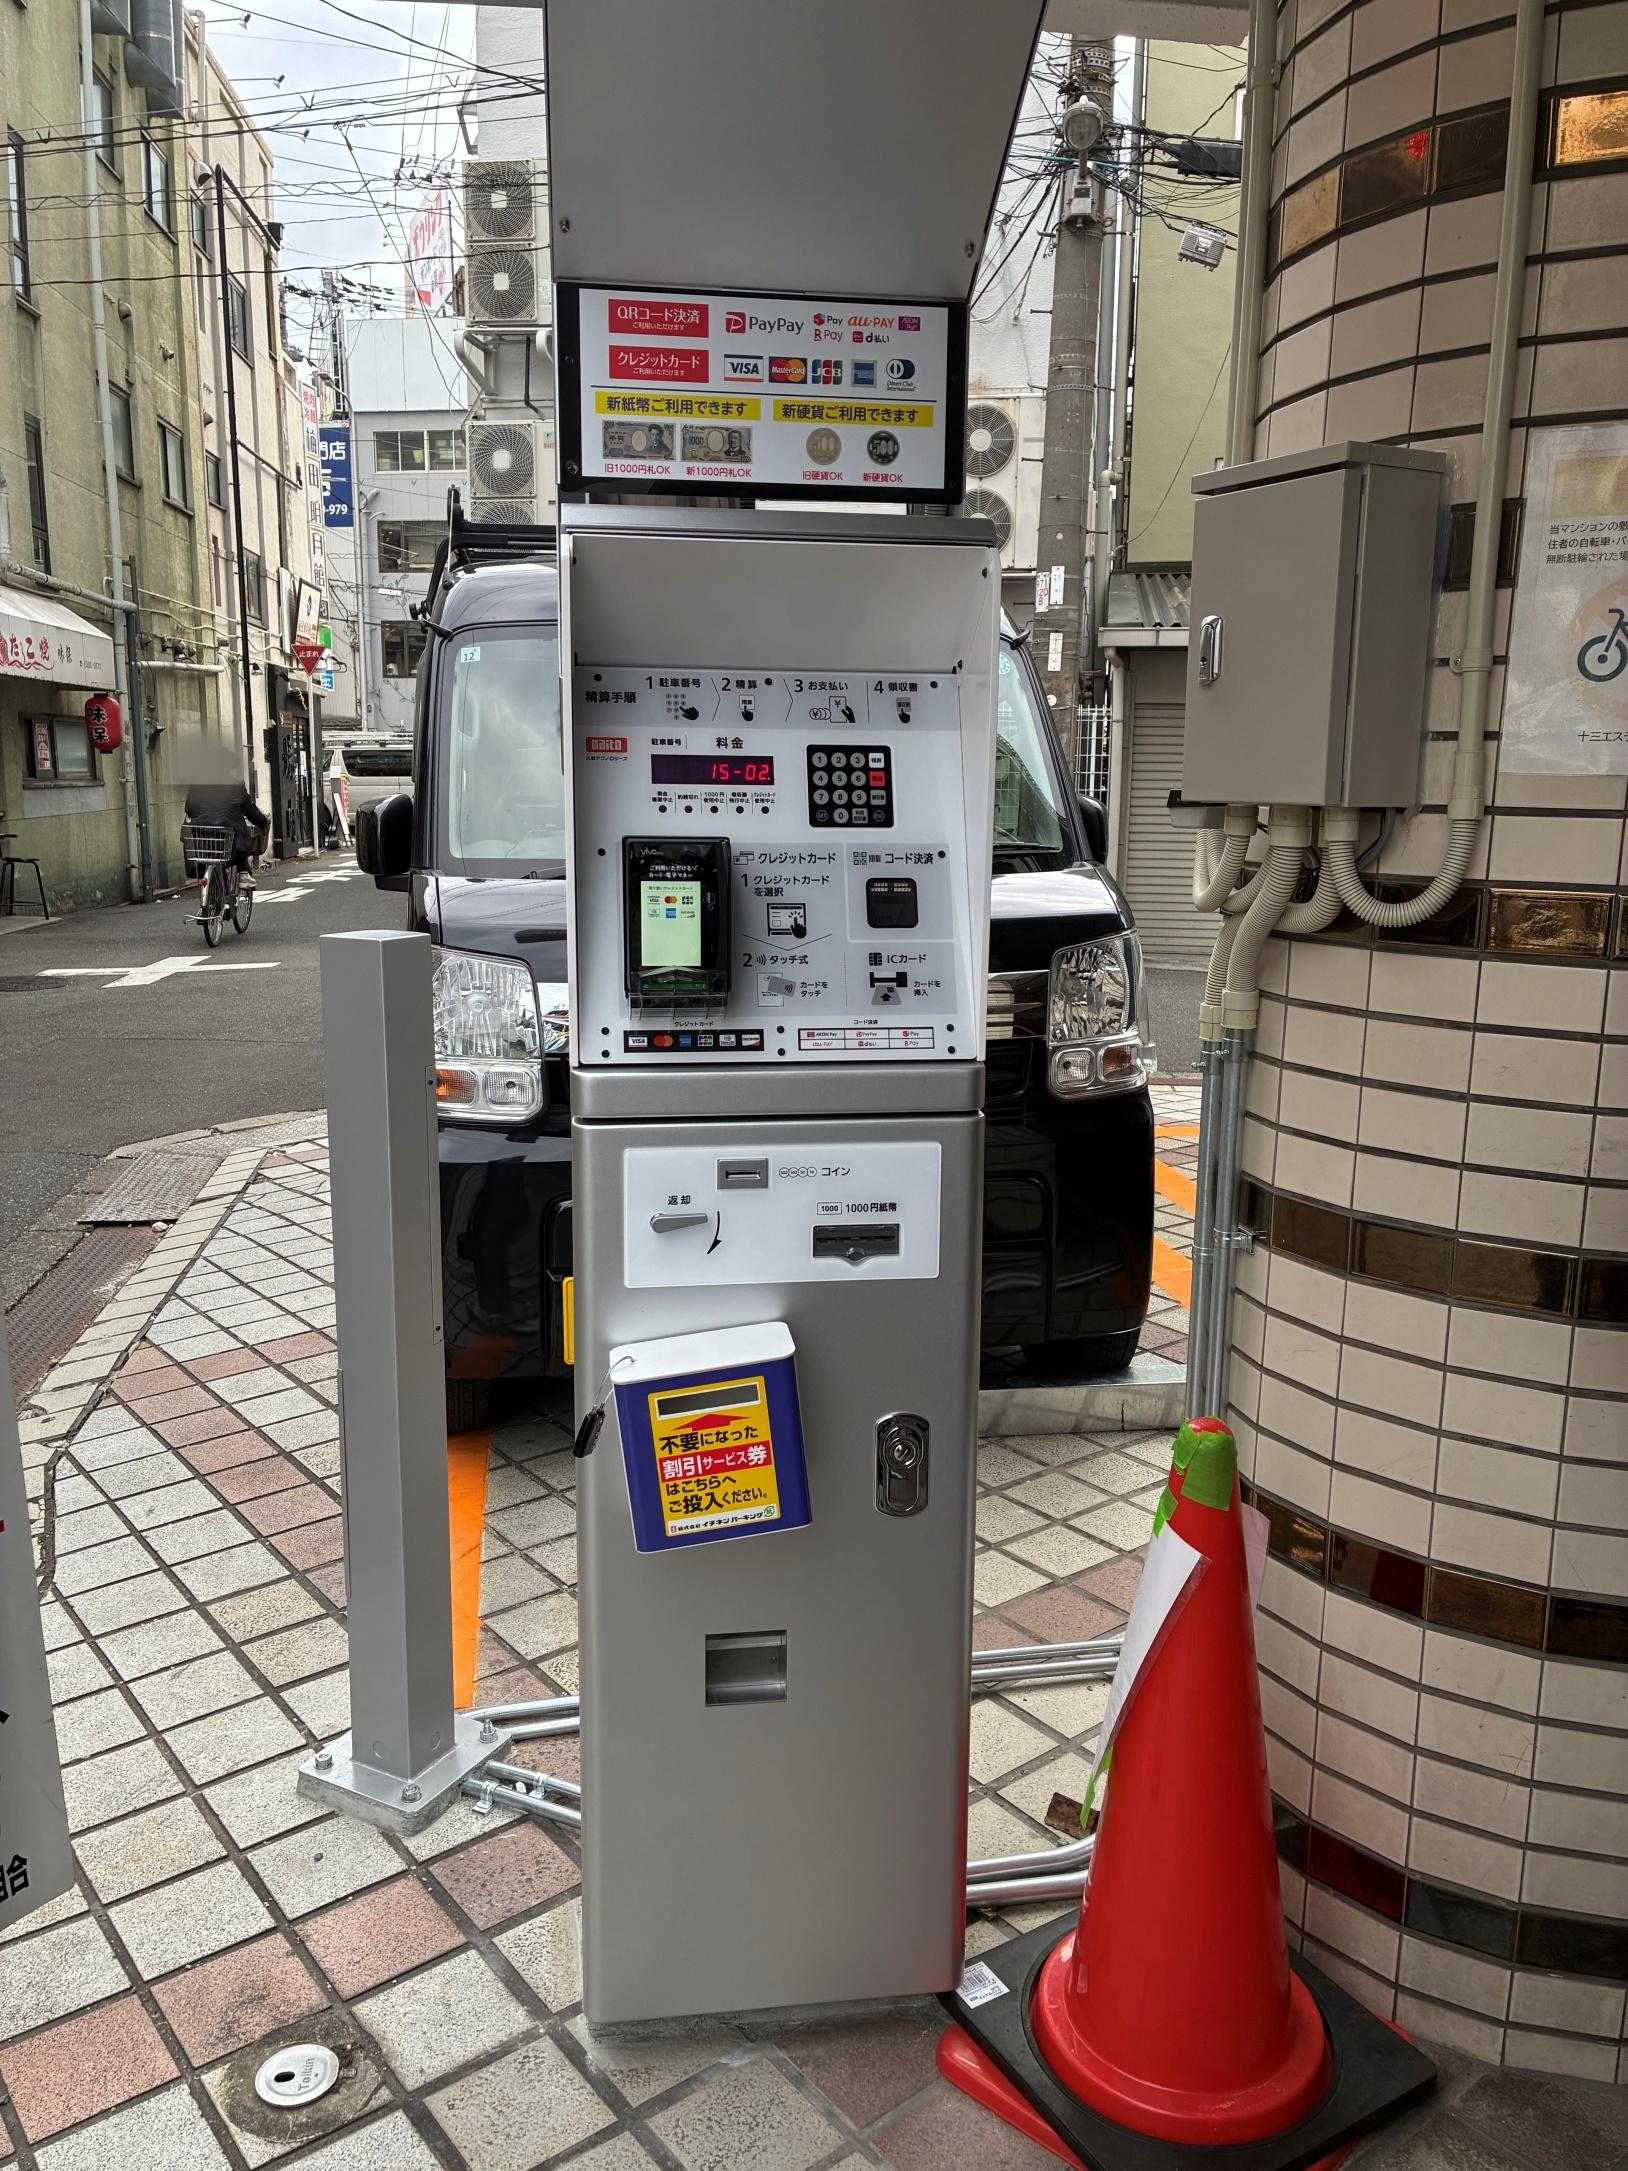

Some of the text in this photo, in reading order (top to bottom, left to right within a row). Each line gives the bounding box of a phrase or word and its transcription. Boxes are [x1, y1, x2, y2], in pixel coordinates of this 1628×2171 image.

[617, 306, 700, 324] QRコード決済
[827, 316, 843, 326] Pay
[633, 322, 685, 331] ご利用いただけます
[750, 316, 804, 335] PayPay
[848, 316, 894, 328] au PAY
[824, 330, 843, 342] Pay
[866, 332, 890, 343] d払い
[618, 352, 700, 369] クレジットカード
[633, 368, 685, 376] ご利用いただけます
[730, 362, 759, 374] VISA
[812, 368, 842, 376] JCB
[607, 396, 747, 416] 新紙幣ご利用できます
[782, 404, 918, 423] 新硬貨ご利用できます
[605, 464, 670, 475] 旧1000円札OK
[686, 466, 752, 477] 新1000円札OK
[803, 471, 843, 481] 旧硬貨OK
[863, 473, 903, 482] 新硬貨OK
[1548, 536, 1628, 549] 住者の自転車・バ
[10, 634, 50, 662] たこ焼
[464, 652, 475, 661] 12
[646, 676, 701, 689] 1 駐車番号
[721, 677, 758, 691] 2 精算
[794, 679, 848, 693] 3 お支払い
[874, 680, 918, 694] 4 領収書
[585, 691, 636, 704] 精算手順
[88, 704, 110, 742] 味保
[651, 738, 682, 746] 駐車番号
[716, 736, 744, 750] 料金
[758, 852, 836, 864] クレジットカード
[885, 851, 934, 865] コード決済
[740, 874, 829, 887] 1 クレジットカード
[754, 887, 784, 897] を選択
[743, 953, 808, 967] 2 タッチ式
[887, 954, 926, 964] ICカード
[822, 1167, 850, 1176] コイン
[667, 1195, 691, 1206] 返却
[845, 1203, 897, 1213] 1000円紙幣
[659, 1426, 759, 1455] 不要になった
[662, 1446, 767, 1480] 割引サービス券
[666, 1476, 736, 1496] はこちらへ
[669, 1488, 768, 1514] ご投入ください。
